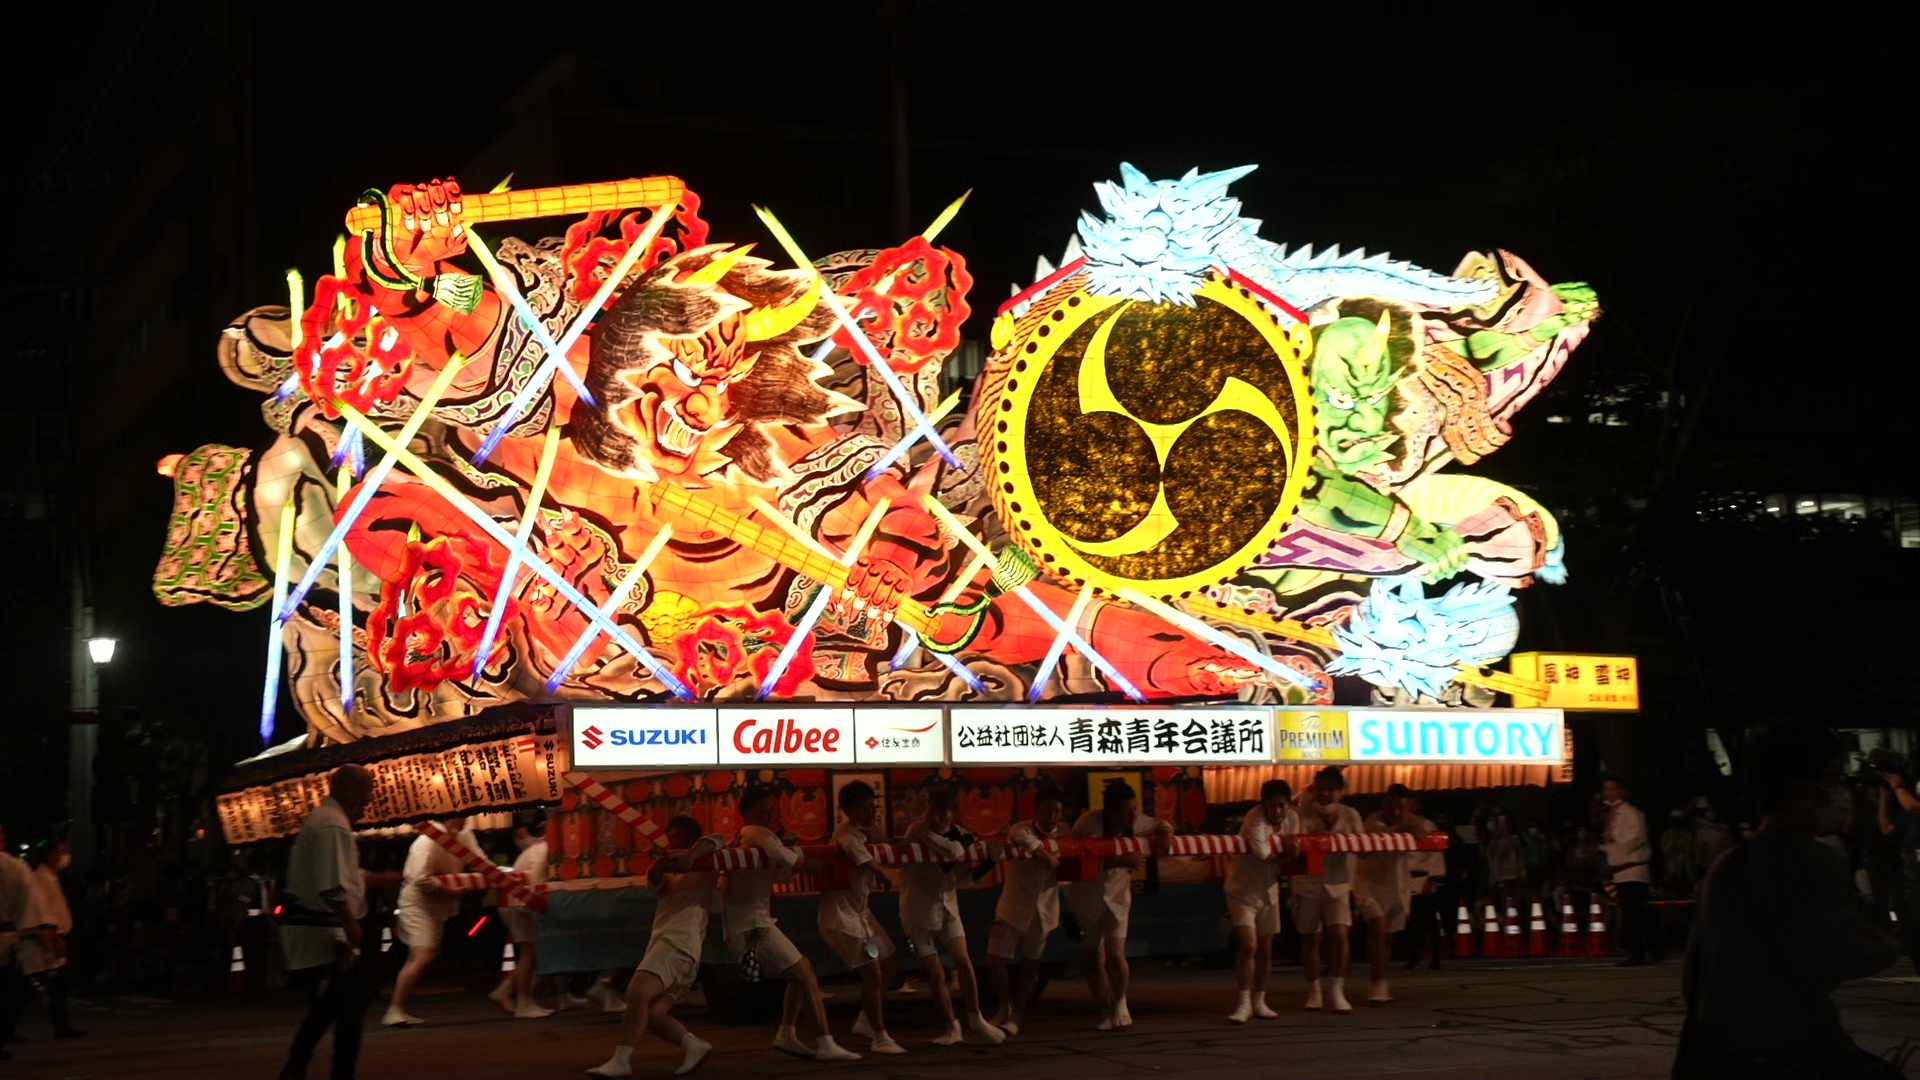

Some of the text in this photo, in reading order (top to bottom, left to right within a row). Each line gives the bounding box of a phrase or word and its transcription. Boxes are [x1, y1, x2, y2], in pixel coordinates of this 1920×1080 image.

[610, 729, 706, 745] SUZUKI
[733, 718, 840, 754] Calbee
[1279, 730, 1345, 748] PREMIUM
[1360, 719, 1554, 757] SUNTORY
[547, 754, 562, 804] SUZUKI
